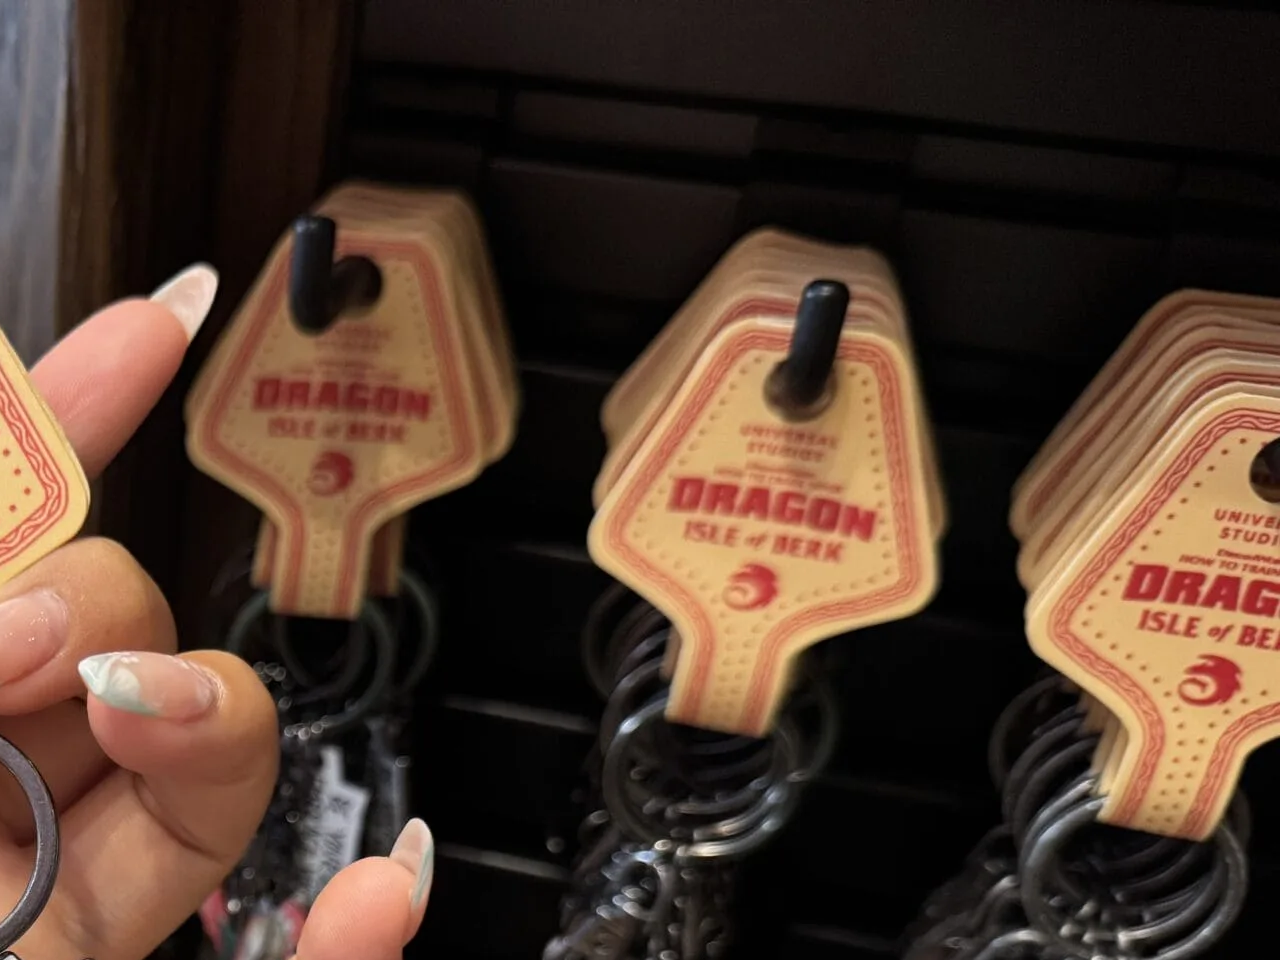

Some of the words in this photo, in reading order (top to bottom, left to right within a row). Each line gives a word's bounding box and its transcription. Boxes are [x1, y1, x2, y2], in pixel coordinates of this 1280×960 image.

[667, 476, 877, 543] DRAGON
[1214, 508, 1280, 530] UNIVE
[684, 520, 741, 548] ISLE
[771, 534, 845, 564] BERK
[1122, 564, 1280, 619] DRAG
[1136, 609, 1202, 639] ISLE
[1207, 624, 1234, 642] of
